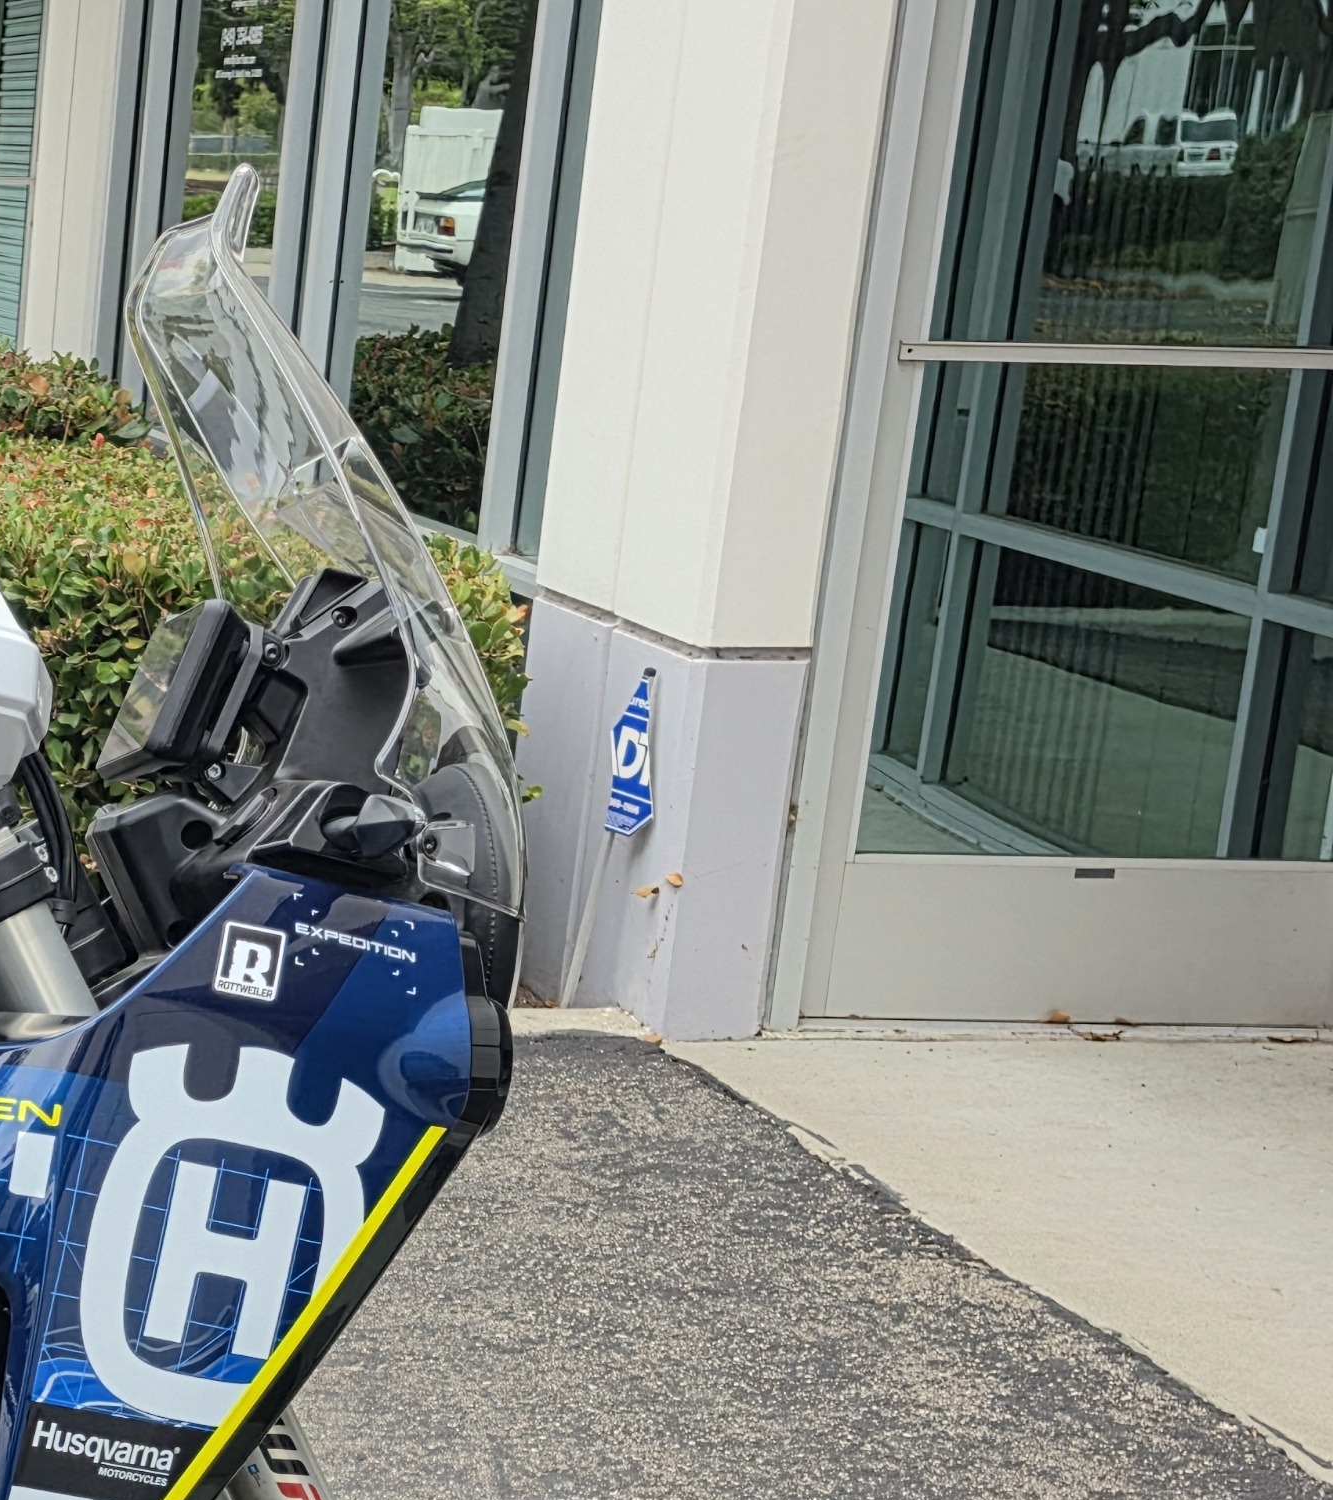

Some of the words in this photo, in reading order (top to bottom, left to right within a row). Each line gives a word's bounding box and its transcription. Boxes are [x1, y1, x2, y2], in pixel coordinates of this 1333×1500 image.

[295, 922, 416, 963] EXPEDITION
[217, 980, 273, 998] ROTTWEILER
[32, 1420, 176, 1471] Husqvarna
[98, 1467, 167, 1486] MOTORCYCLES
